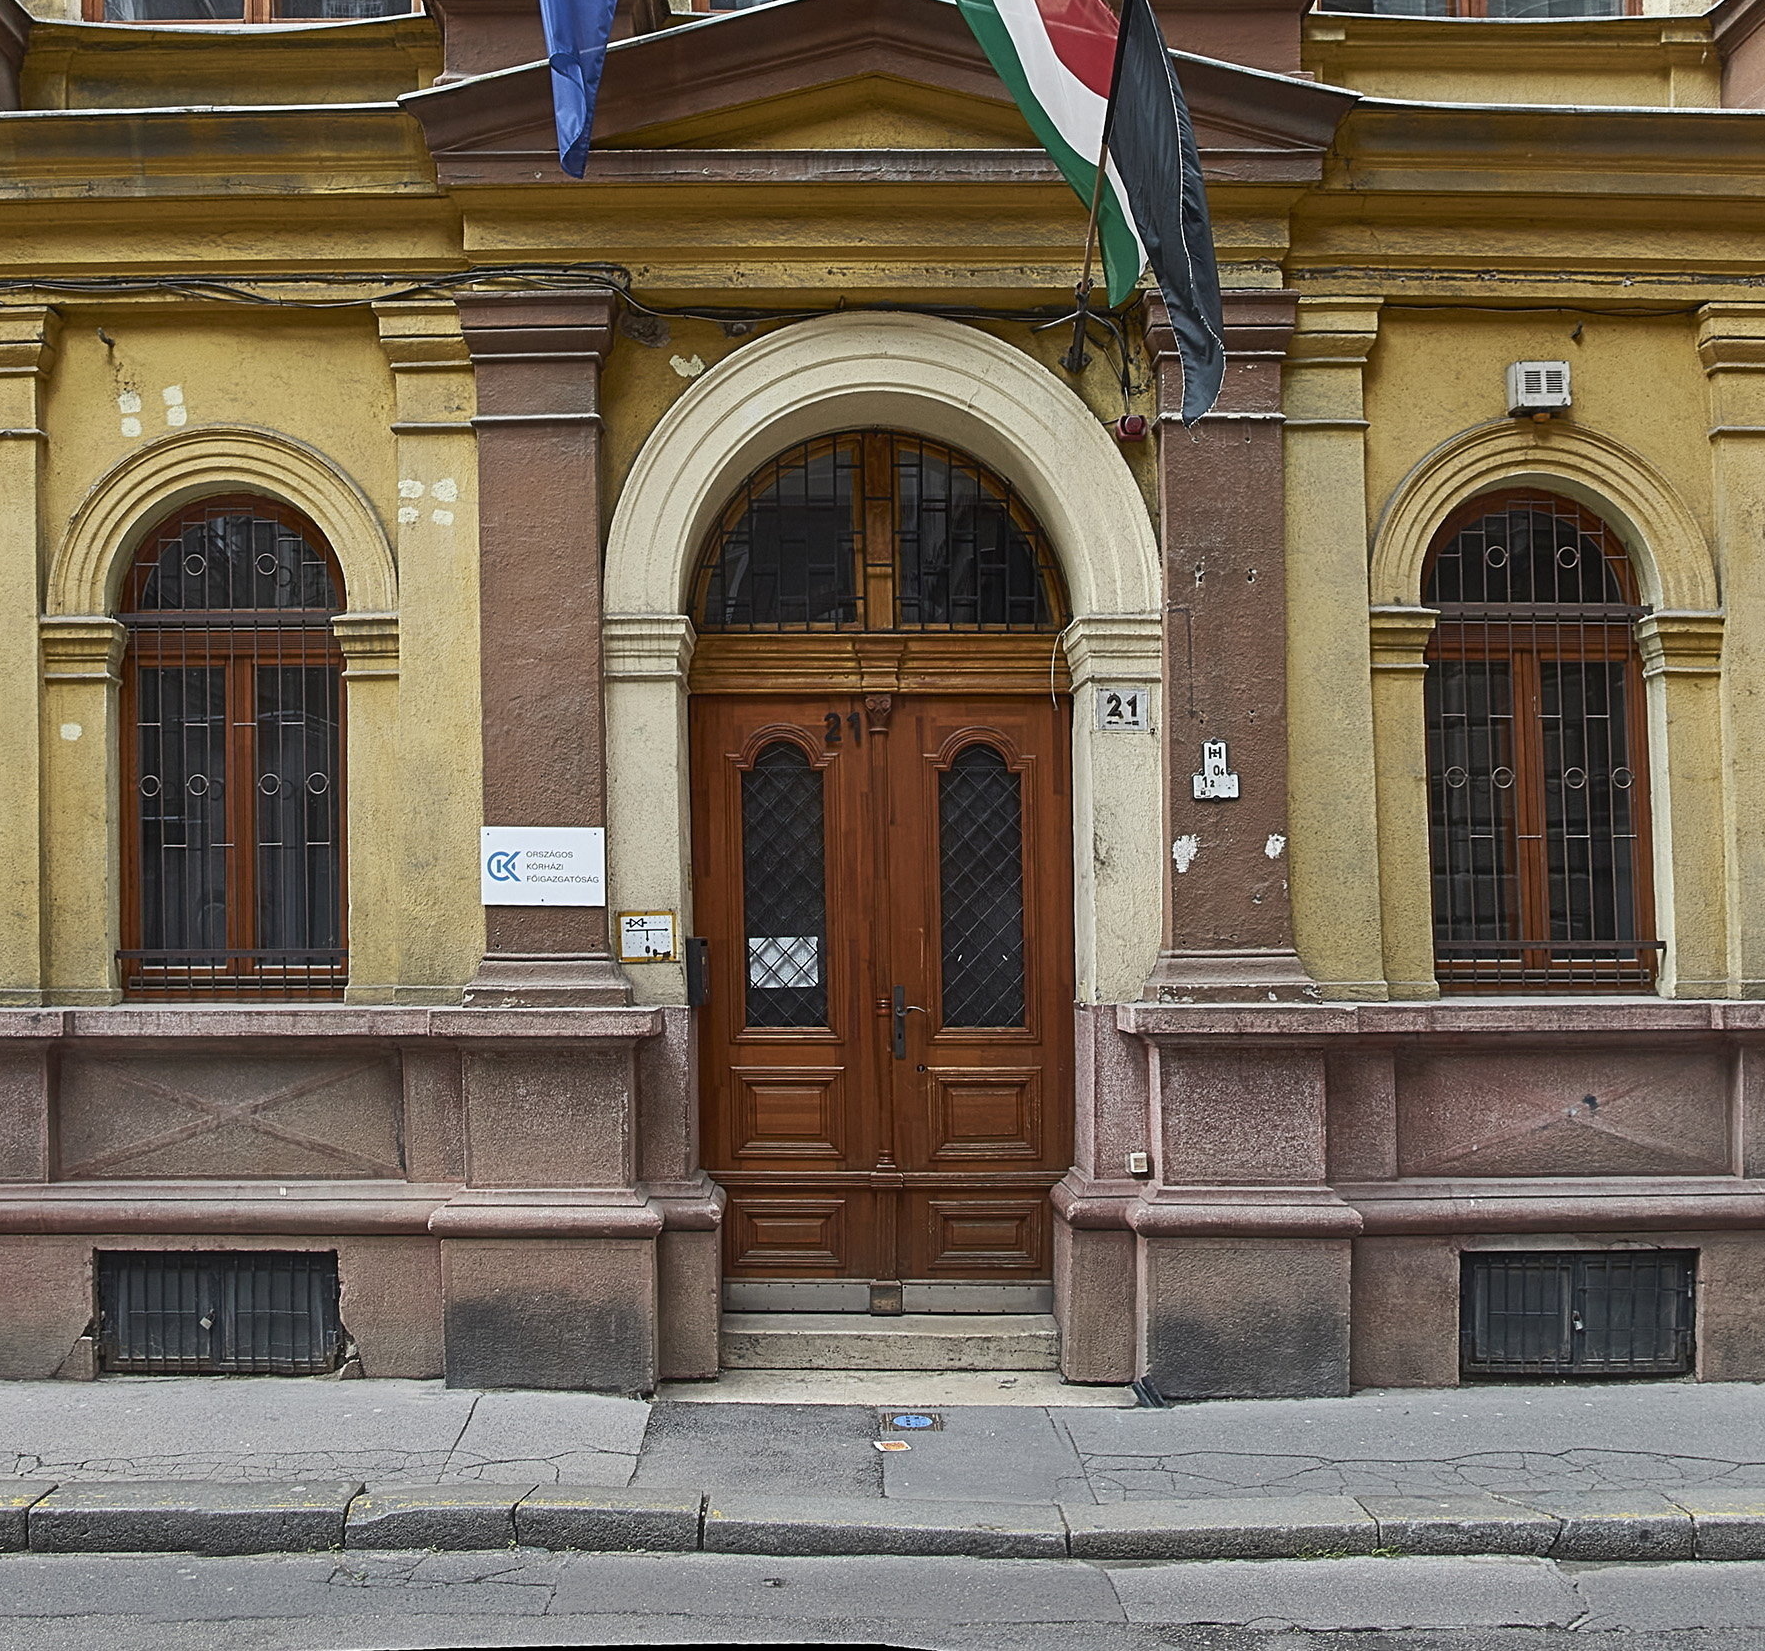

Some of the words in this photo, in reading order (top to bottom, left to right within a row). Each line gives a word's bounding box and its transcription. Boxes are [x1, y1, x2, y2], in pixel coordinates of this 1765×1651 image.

[1107, 692, 1138, 719] 21
[824, 712, 861, 745] 21
[526, 850, 574, 858] ORSZÁGOS
[526, 863, 564, 871] KÓRHÁZI
[526, 875, 600, 884] FŐIGAZGATÓSÁG
